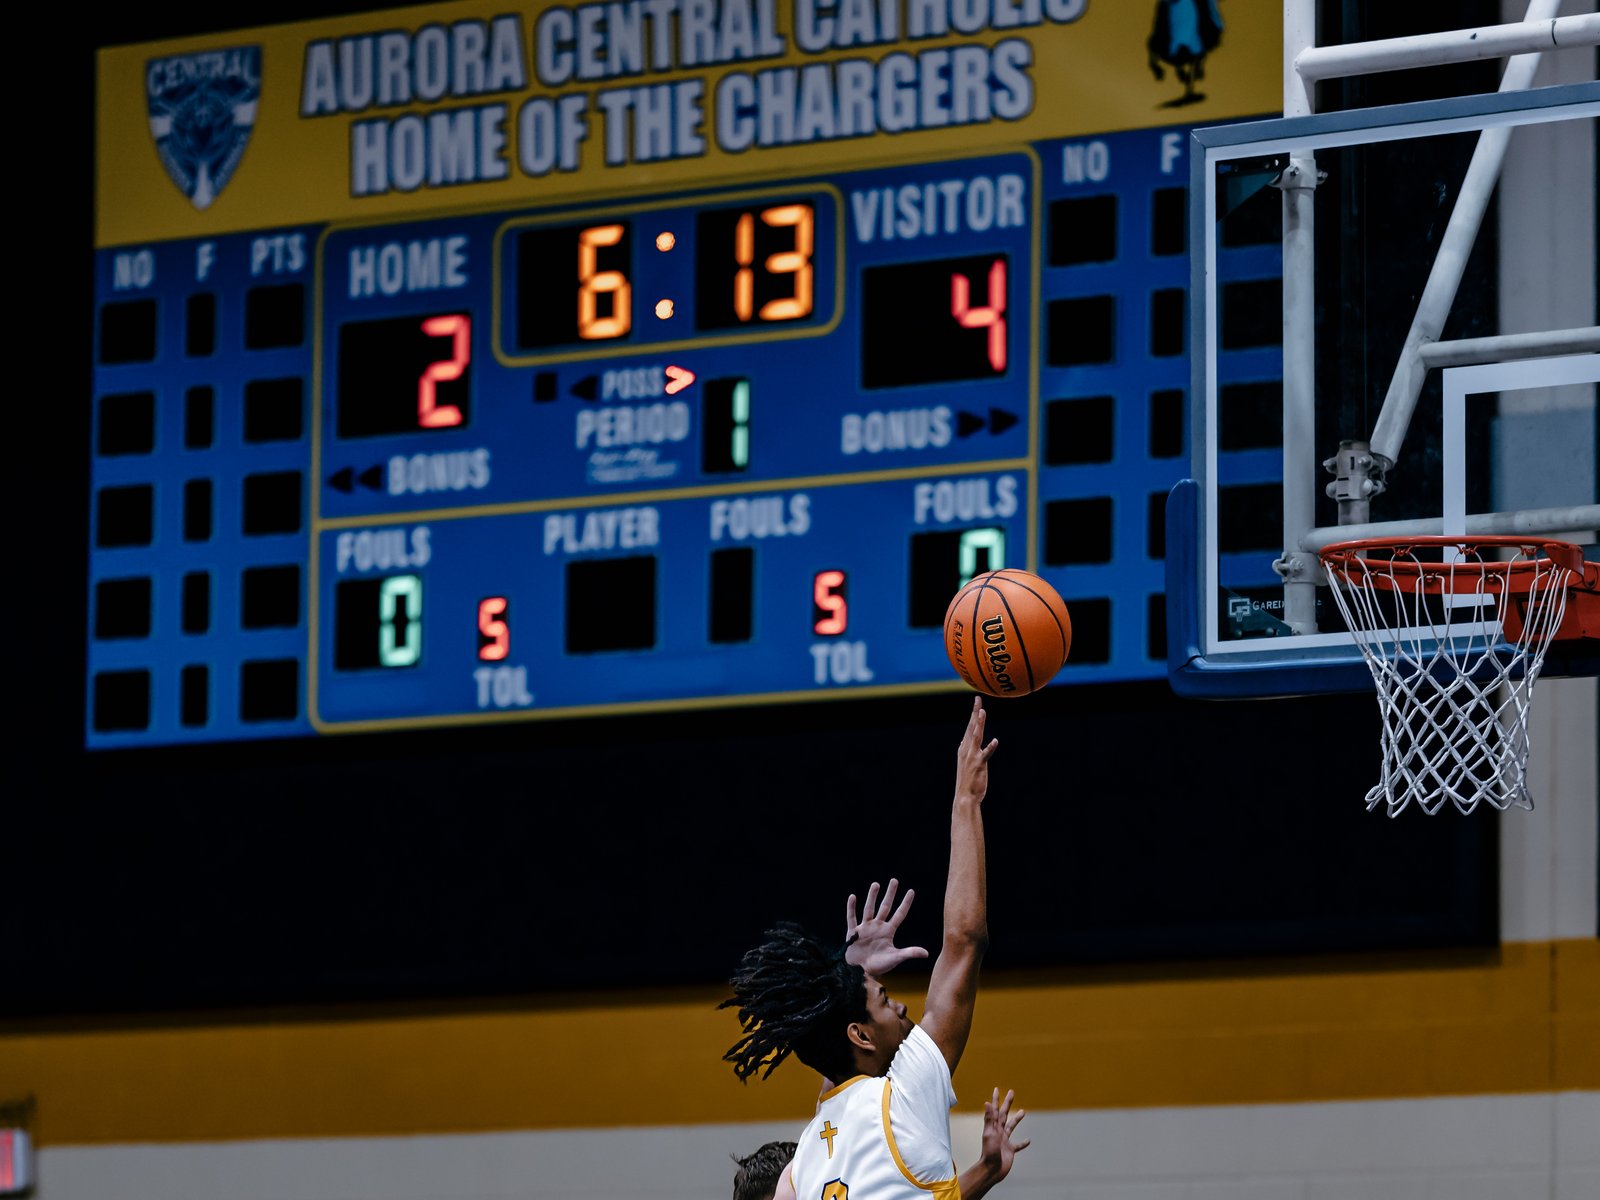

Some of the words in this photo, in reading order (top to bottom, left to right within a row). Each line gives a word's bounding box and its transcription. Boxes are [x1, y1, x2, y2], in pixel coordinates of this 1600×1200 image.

[302, 15, 525, 115] AURORA
[535, 0, 785, 86] CENTRAL
[795, 0, 1086, 52] CATH
[351, 105, 508, 195] HOME
[518, 95, 588, 176] OF
[597, 82, 706, 166] THE
[716, 38, 1034, 152] CHARGERS
[1062, 142, 1109, 183] NO
[1160, 134, 1182, 173] F
[852, 174, 1025, 242] VISITOR
[113, 250, 154, 288] NO
[196, 243, 216, 280] F
[251, 235, 305, 274] PTS
[348, 237, 468, 297] HOME
[952, 258, 1007, 371] 4
[418, 314, 471, 428] 2
[603, 367, 662, 400] POSS
[576, 402, 690, 449] PERIOD
[732, 381, 750, 467] 1
[841, 406, 952, 455] BONUS
[387, 448, 490, 495] BONUS
[709, 494, 811, 541] FOULS
[914, 475, 1018, 524] FOULS
[336, 526, 431, 573] FOULS
[543, 506, 660, 555] PLAYER
[379, 574, 423, 667] 0
[810, 641, 874, 685] TOL
[981, 614, 1017, 692] Wilson
[474, 665, 534, 708] TOL
